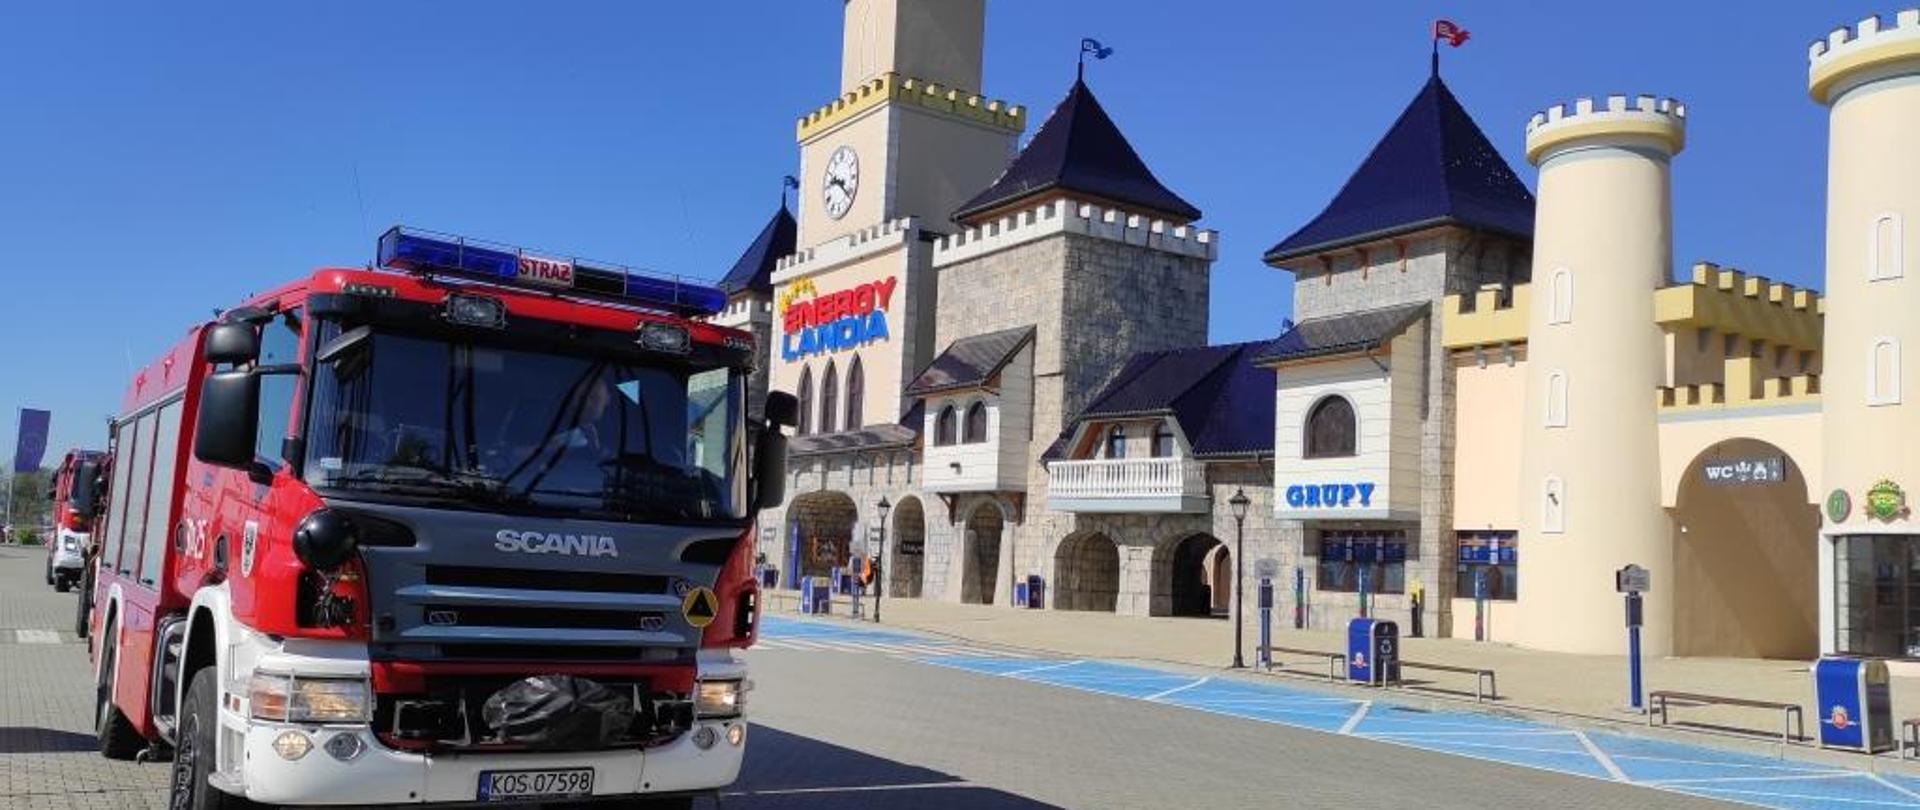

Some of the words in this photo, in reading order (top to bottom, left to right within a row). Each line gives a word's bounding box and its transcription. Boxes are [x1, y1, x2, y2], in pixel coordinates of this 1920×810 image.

[784, 276, 896, 334] ENERGY
[782, 309, 889, 363] LANDIA
[1706, 466, 1734, 480] WC
[1286, 483, 1375, 507] GRUPY
[494, 529, 618, 557] SCANIA
[491, 774, 528, 794] KOS
[534, 772, 590, 792] 07598
